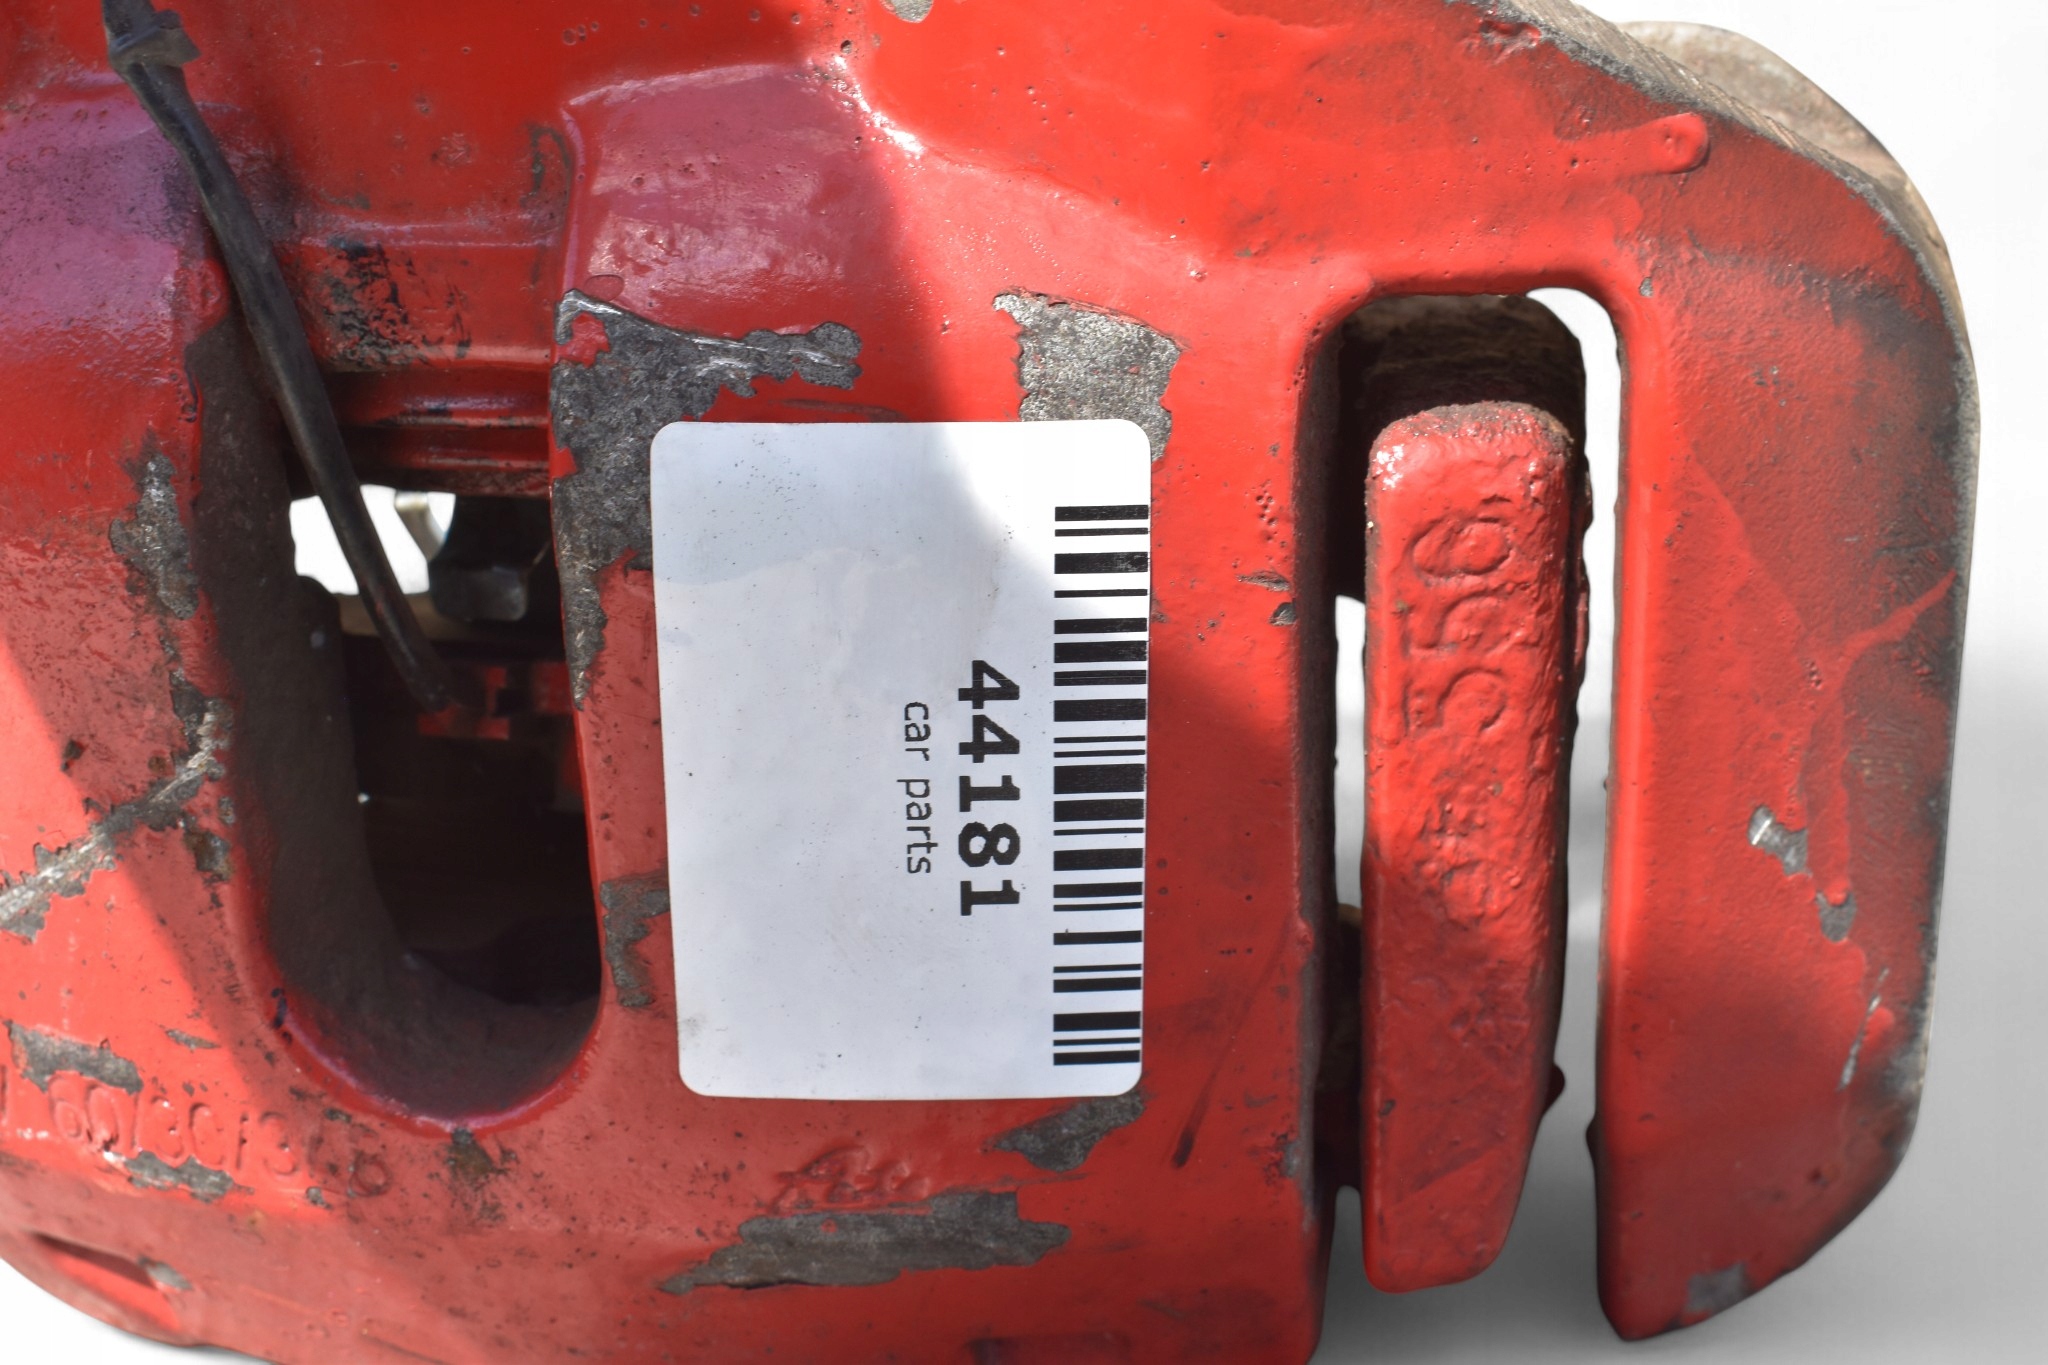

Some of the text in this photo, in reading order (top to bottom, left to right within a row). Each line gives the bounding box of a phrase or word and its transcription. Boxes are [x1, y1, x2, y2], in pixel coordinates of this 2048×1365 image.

[896, 701, 939, 874] car parts
[957, 659, 1021, 917] 44181
